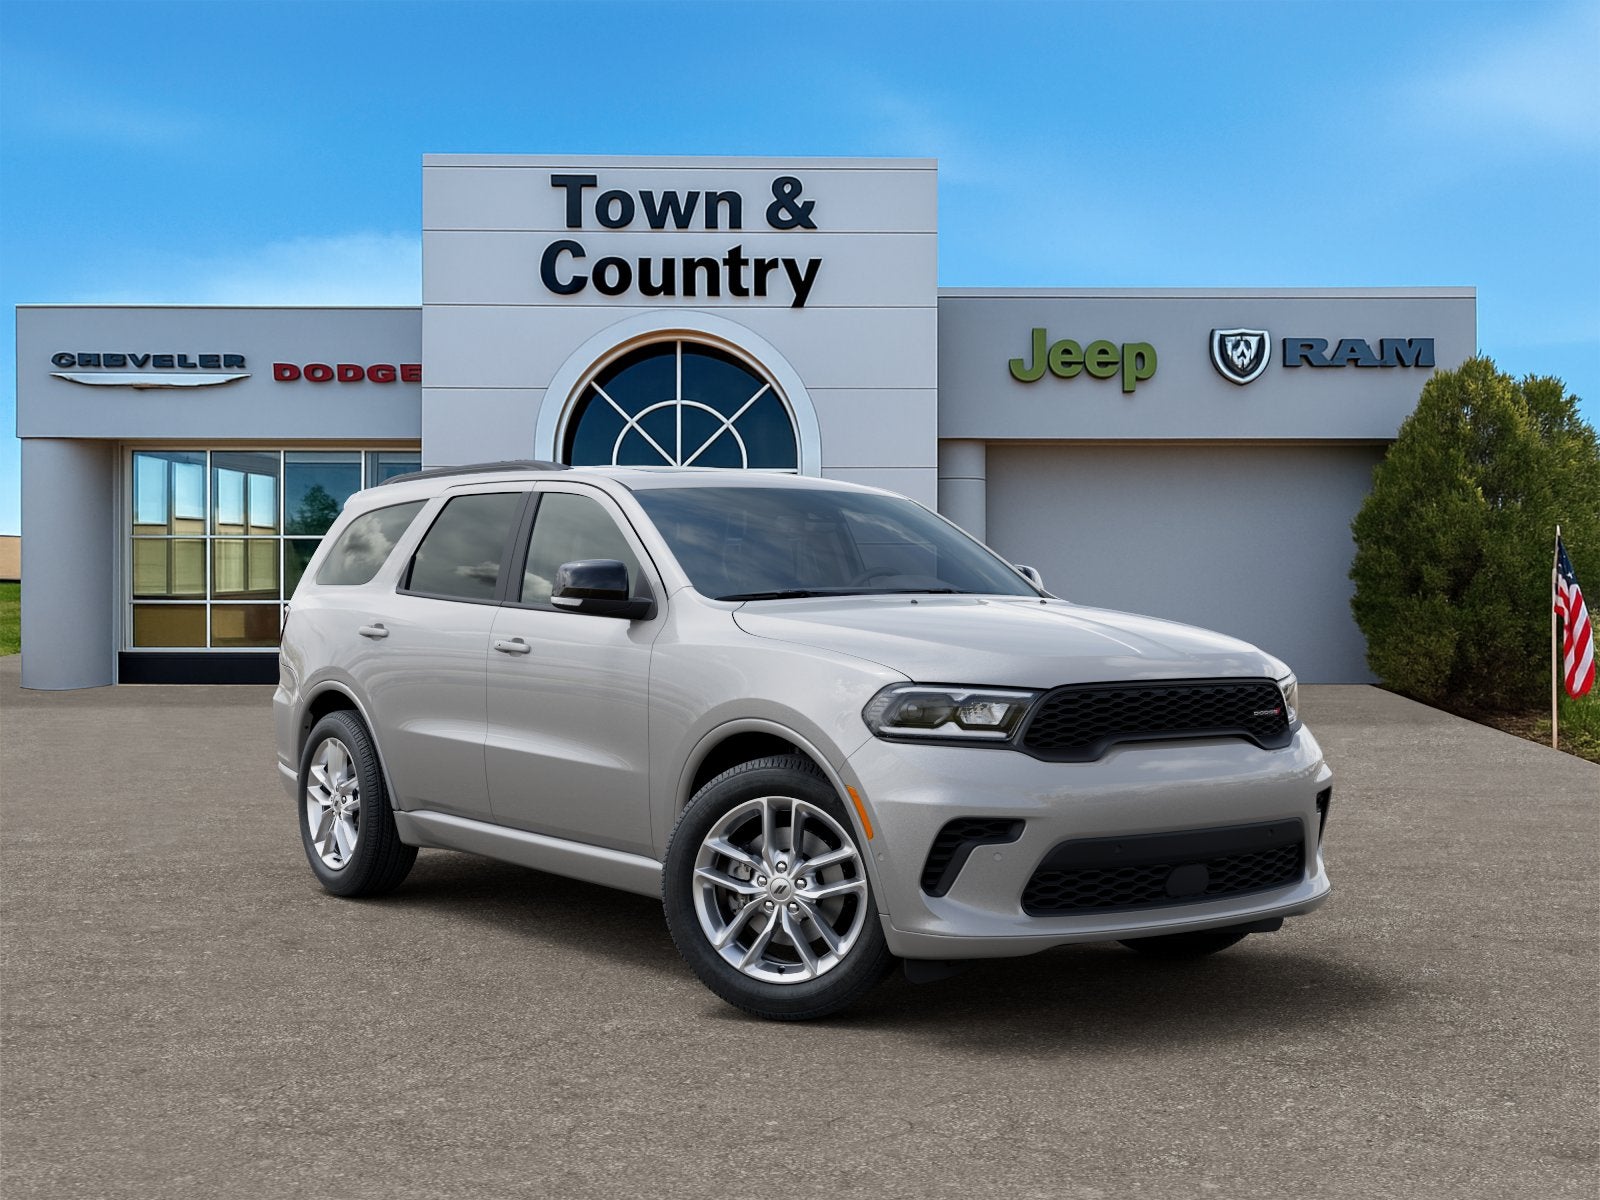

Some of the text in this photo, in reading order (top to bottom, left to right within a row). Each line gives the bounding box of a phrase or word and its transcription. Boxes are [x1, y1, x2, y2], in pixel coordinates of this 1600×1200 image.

[550, 174, 818, 230] Town &
[540, 239, 822, 308] Country
[273, 363, 422, 383] DODGE
[1009, 328, 1157, 392] Jeep
[1283, 338, 1435, 367] RAM
